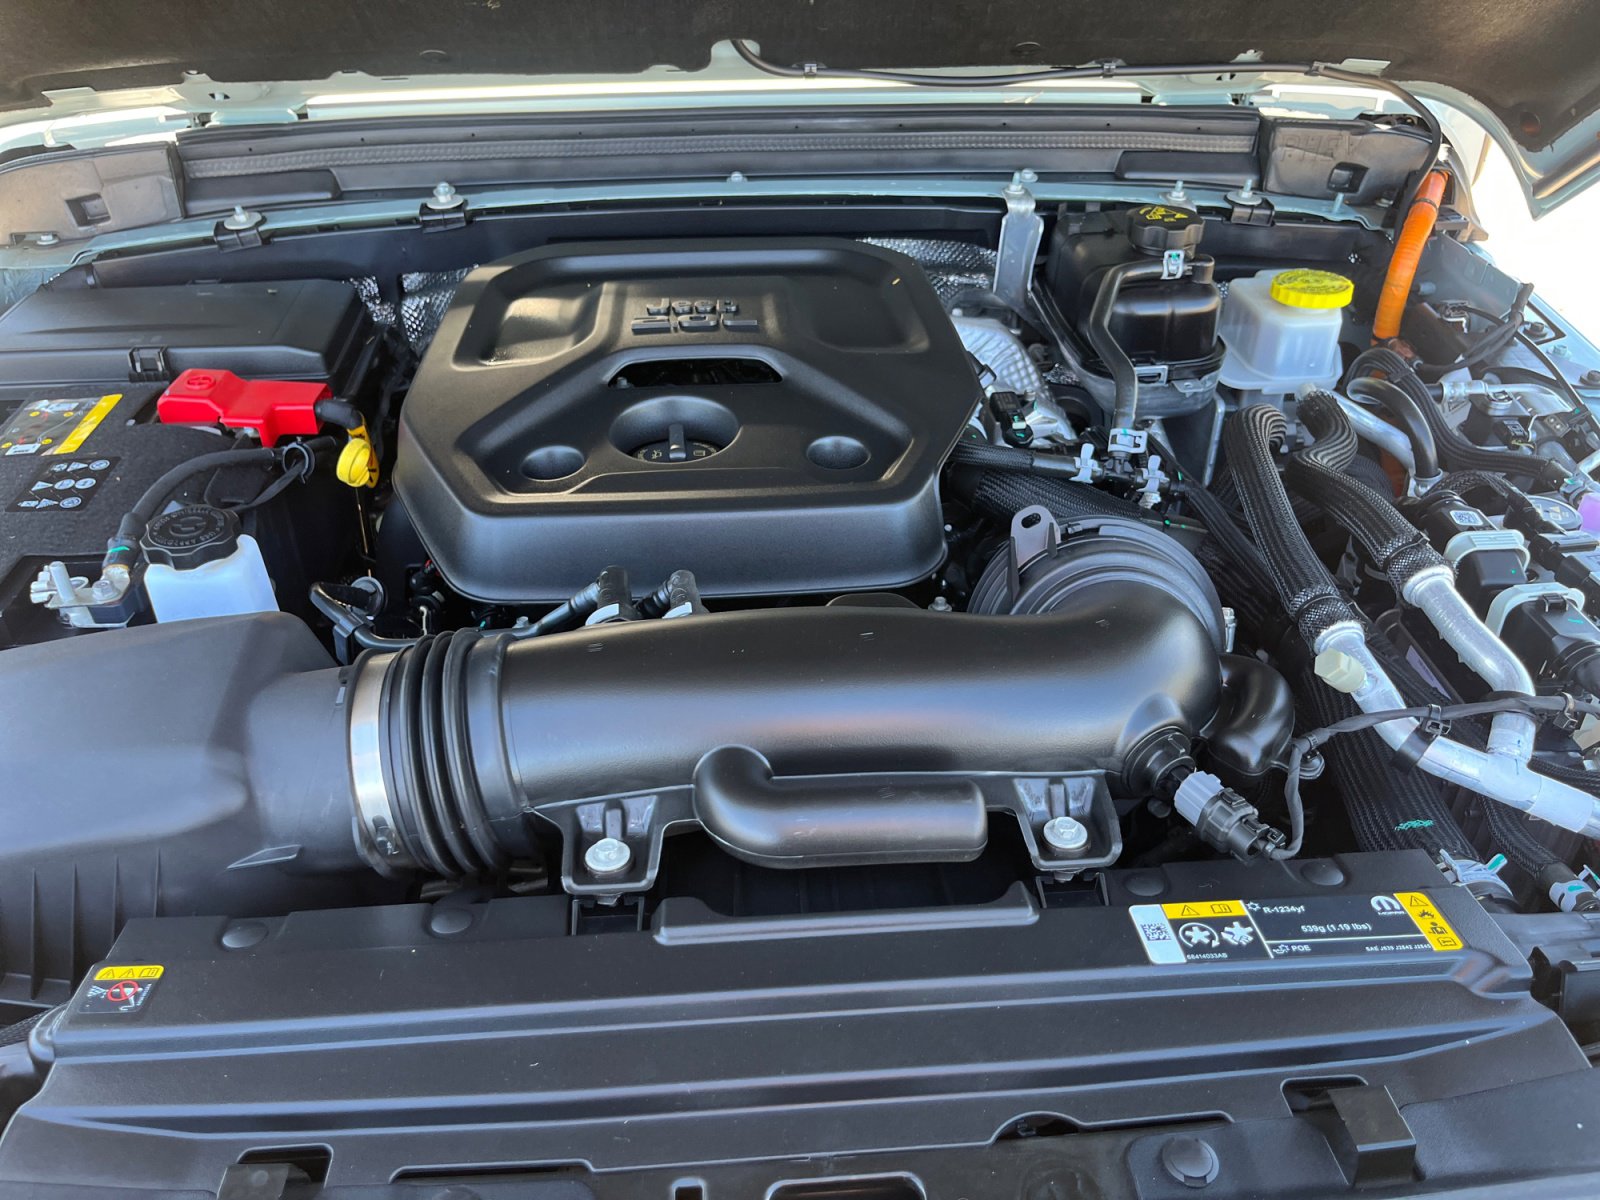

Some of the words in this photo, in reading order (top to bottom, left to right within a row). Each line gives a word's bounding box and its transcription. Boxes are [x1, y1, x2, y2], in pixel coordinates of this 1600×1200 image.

[646, 298, 738, 315] Jeep
[1263, 905, 1305, 914] R-1234yf
[1301, 924, 1326, 933] 539g
[1351, 922, 1372, 931] lbs)
